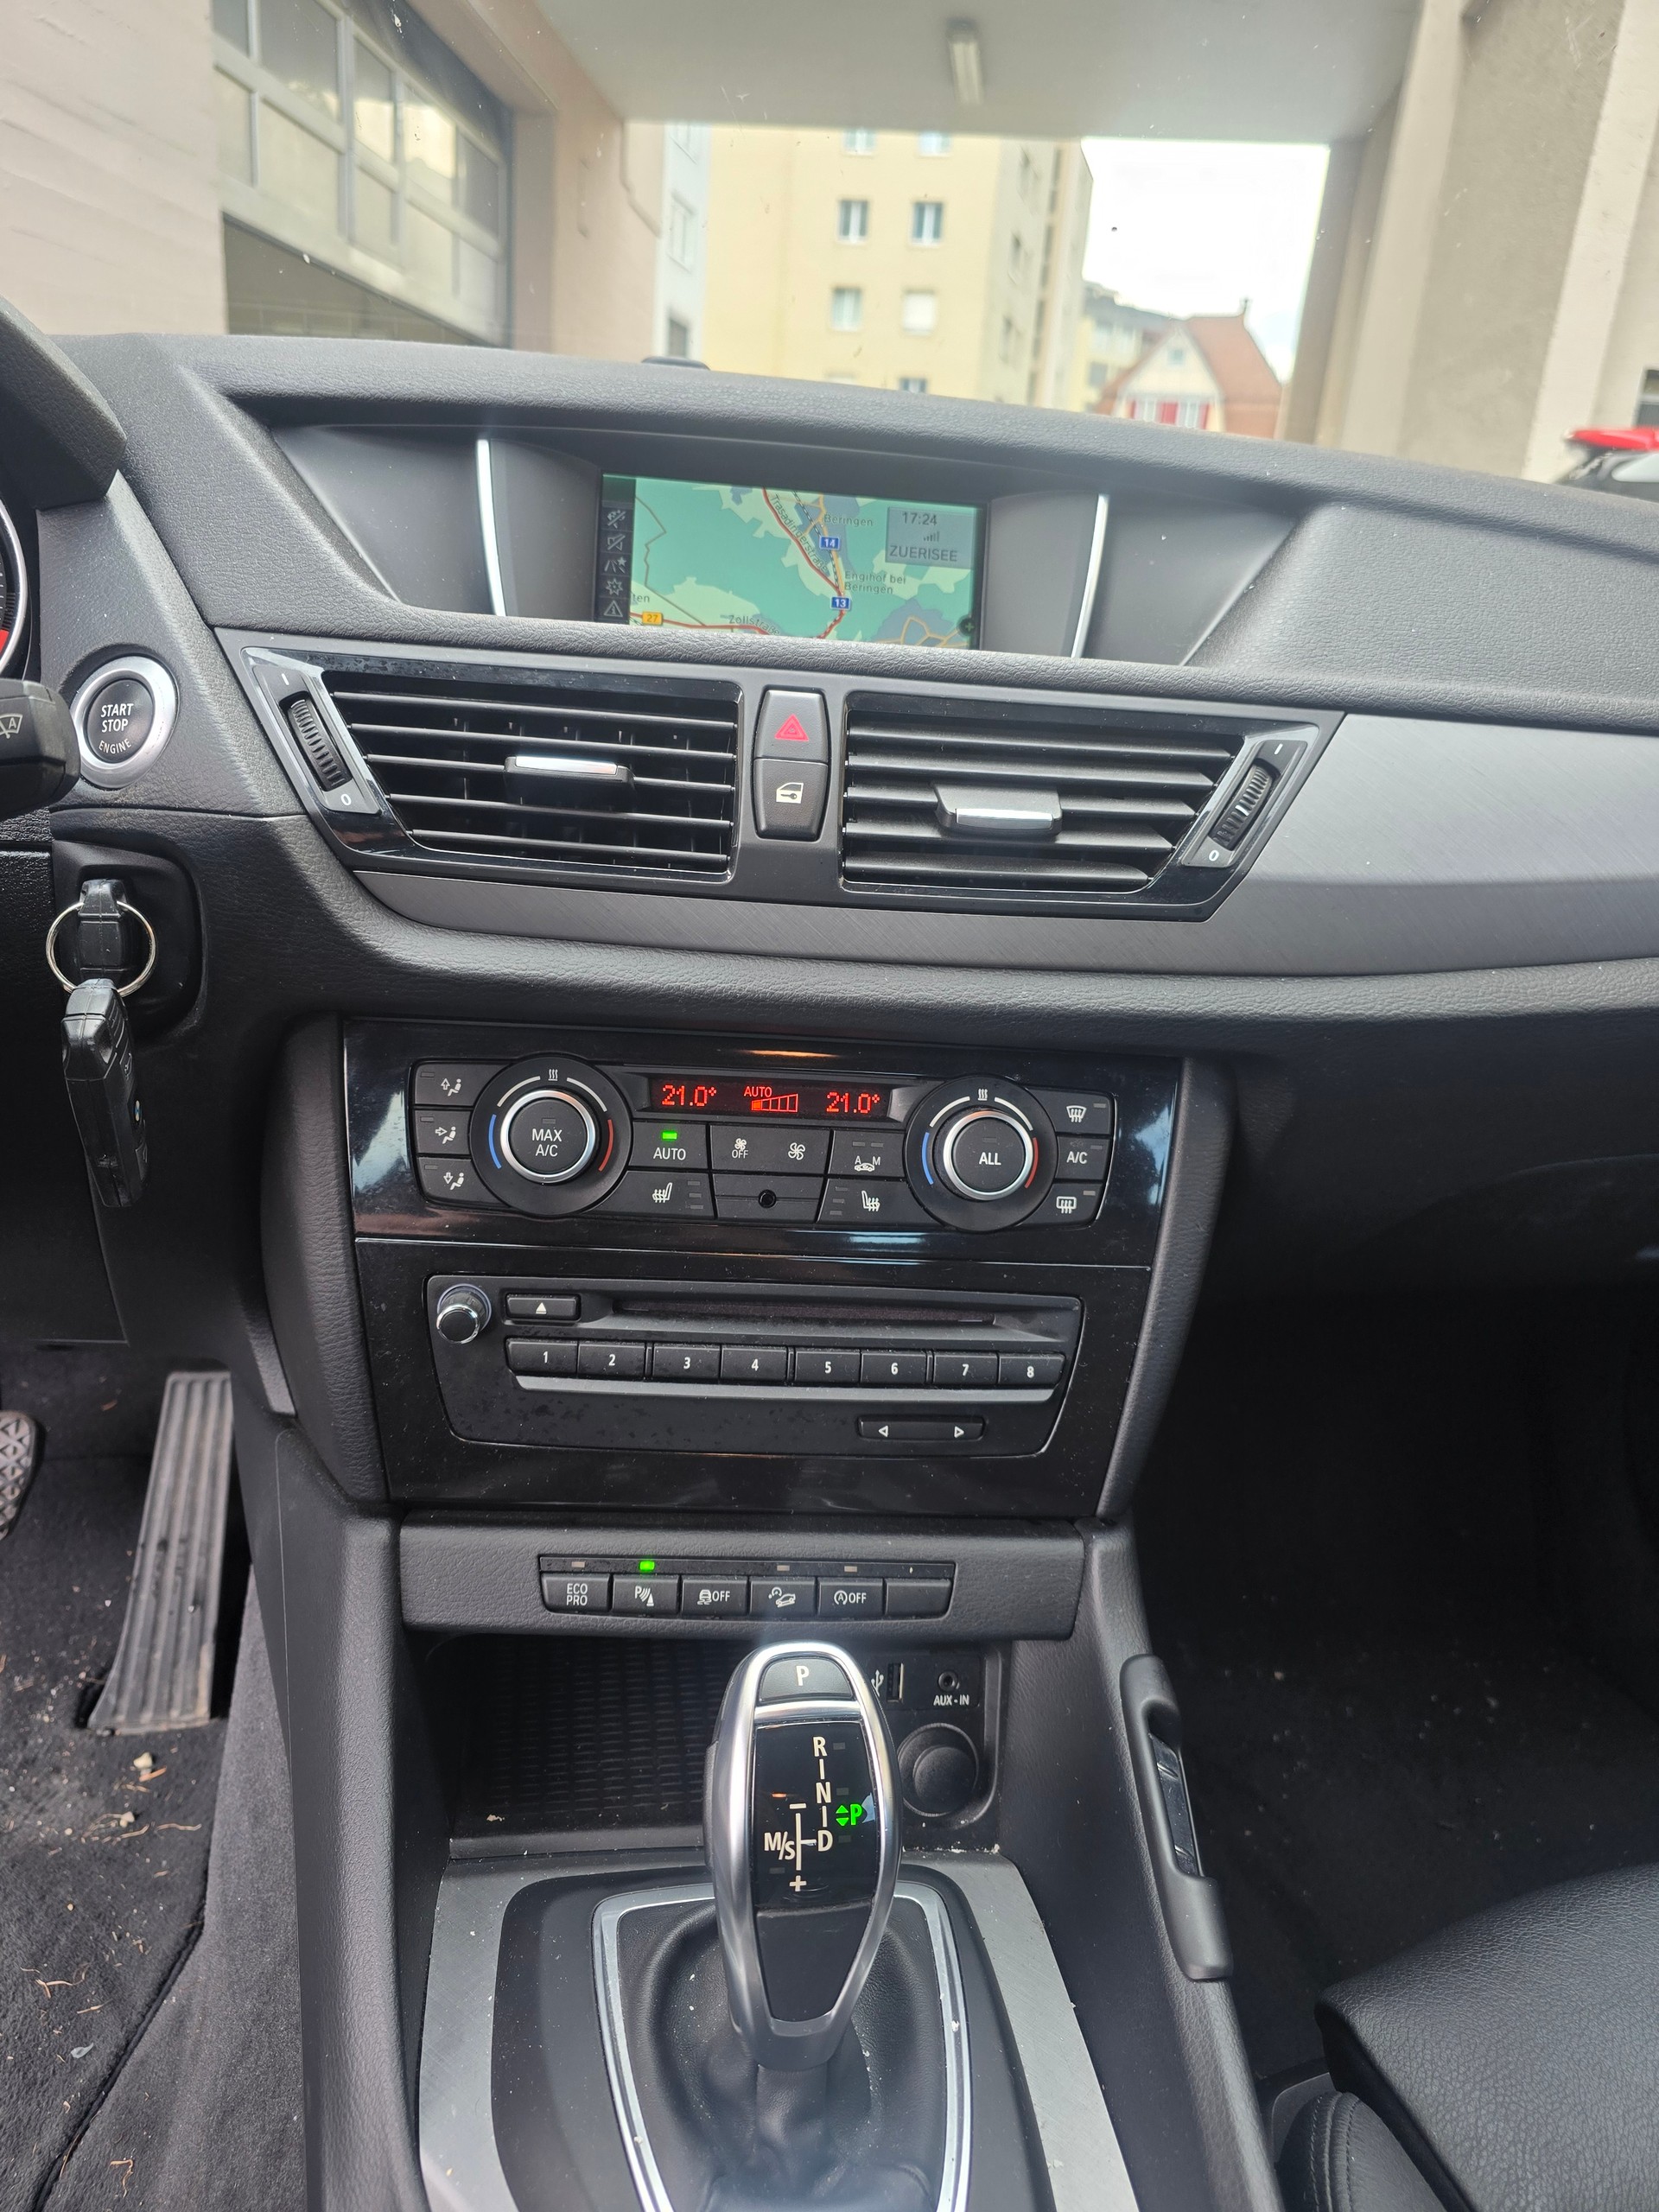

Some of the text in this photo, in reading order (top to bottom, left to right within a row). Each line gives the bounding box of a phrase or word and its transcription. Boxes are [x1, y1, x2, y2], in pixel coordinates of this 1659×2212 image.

[823, 513, 874, 528] Beringen
[902, 512, 938, 526] 17:24
[824, 538, 836, 548] 14
[889, 545, 958, 562] ZUERISEE
[889, 575, 906, 584] bei
[844, 582, 893, 594] Beringen
[835, 598, 847, 608] 13
[646, 613, 658, 623] 27
[100, 703, 134, 718] START
[8, 717, 17, 729] A
[101, 719, 129, 733] STOP
[98, 738, 132, 755] ENGINE
[744, 1085, 773, 1098] AUTO
[531, 1128, 563, 1141] MAX
[535, 1144, 559, 1158] A/C
[653, 1147, 687, 1160] AUTO
[731, 1149, 749, 1160] OFF
[1066, 1151, 1089, 1165] A/C
[854, 1155, 881, 1166] A M
[978, 1151, 1002, 1166] ALL
[543, 1351, 549, 1363] 1
[608, 1353, 616, 1367] 2
[683, 1356, 691, 1370] 3
[751, 1357, 761, 1371] 4
[824, 1360, 832, 1374] 5
[891, 1362, 899, 1376] 6
[962, 1363, 969, 1376] 7
[1027, 1365, 1035, 1379] 8
[566, 1583, 588, 1595] ECO
[634, 1586, 642, 1599] P
[566, 1593, 588, 1606] PRO
[712, 1590, 731, 1603] OFF
[849, 1592, 867, 1605] OFF
[796, 1665, 810, 1686] P
[813, 1736, 827, 1757] R
[817, 1783, 831, 1803] N
[849, 1803, 862, 1826] P
[764, 1832, 796, 1860] M/S
[817, 1830, 833, 1852] D
